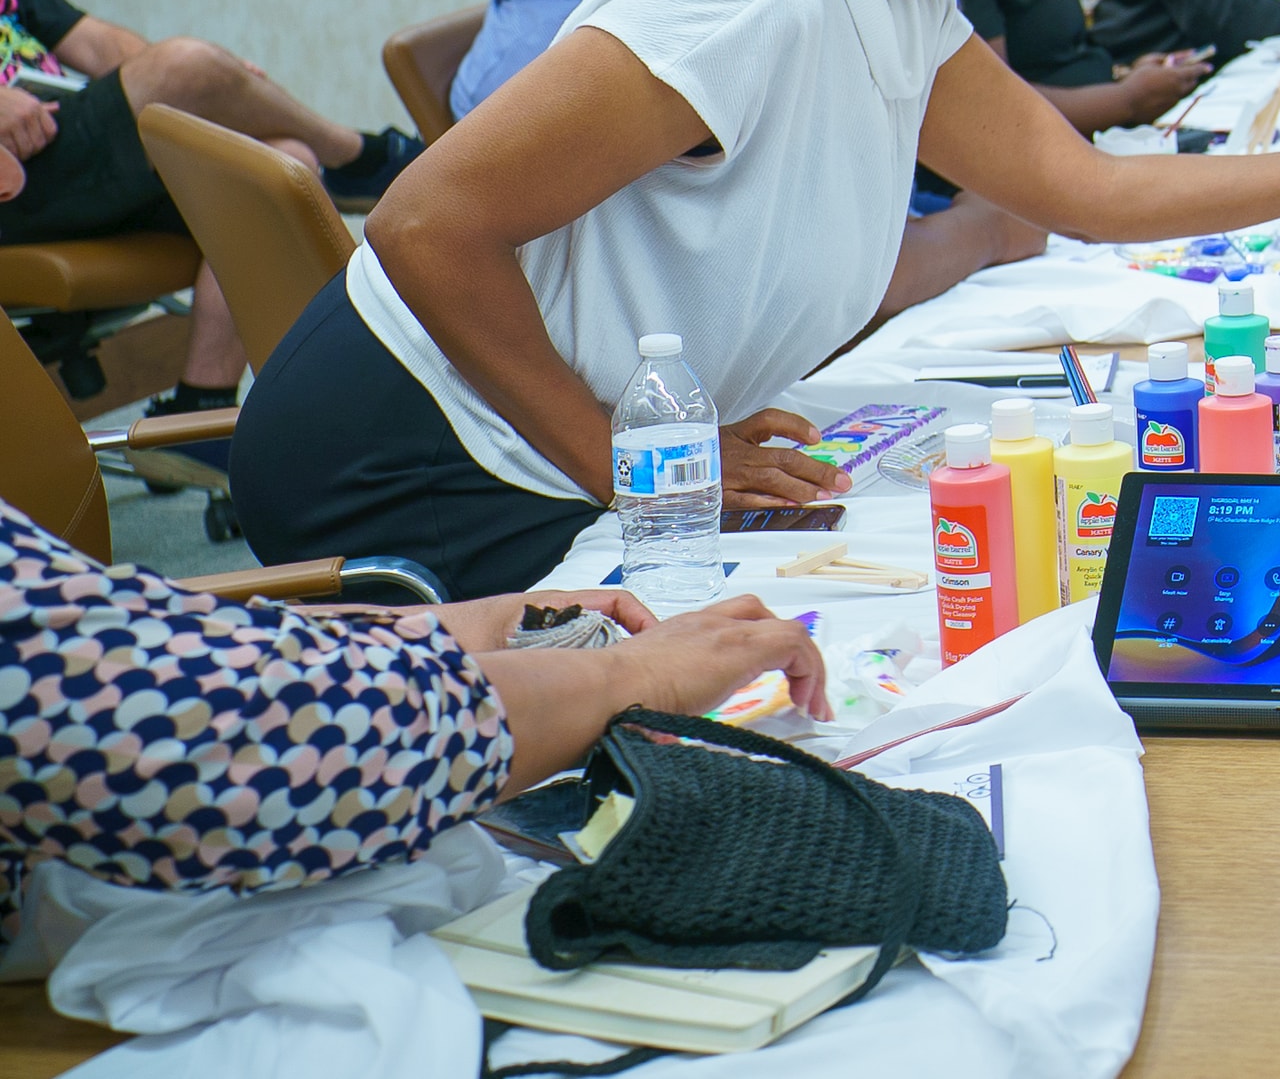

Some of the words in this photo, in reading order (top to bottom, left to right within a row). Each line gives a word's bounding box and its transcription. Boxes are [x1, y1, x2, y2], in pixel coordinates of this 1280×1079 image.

[1208, 505, 1233, 515] 8:19
[1235, 505, 1254, 515] PM
[1076, 547, 1102, 558] Canary
[941, 576, 970, 586] Crimson
